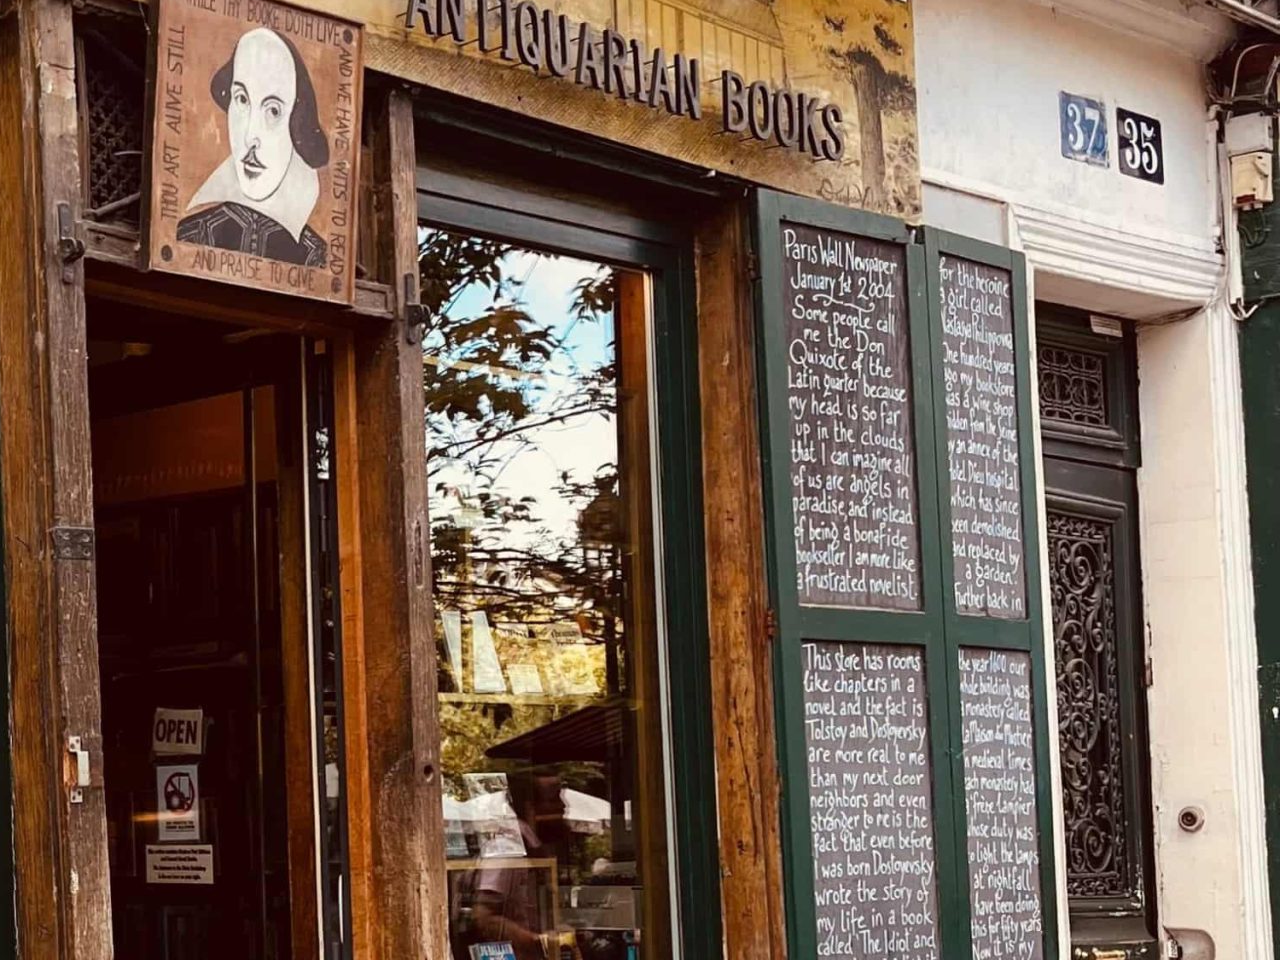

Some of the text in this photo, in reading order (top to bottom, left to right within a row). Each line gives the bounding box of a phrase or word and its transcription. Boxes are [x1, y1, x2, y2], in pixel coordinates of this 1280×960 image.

[247, 1, 280, 31] BOOKE
[284, 9, 314, 36] DOTH
[161, 25, 185, 220] THOU ART ALIVE STILL
[722, 69, 845, 165] BOOKS
[1067, 103, 1100, 155] 37
[330, 46, 353, 276] AND WE HAVE WITS TO READ
[1124, 117, 1158, 174] 35
[192, 248, 316, 290] AND PRAISE TO GIVE
[784, 229, 898, 283] Paris Wall Newspaper
[790, 262, 895, 308] January 1st 2004
[948, 288, 1003, 319] girl called
[792, 294, 896, 336] Some people call
[789, 338, 894, 378] Quixote of the
[803, 325, 885, 356] me the Don
[787, 365, 907, 402] Latin quarter because
[788, 393, 901, 429] my head is so far
[795, 421, 904, 452] up in the clouds
[791, 440, 911, 480] that I can imagine all
[793, 465, 910, 505] of us are angels in
[848, 500, 868, 517] and
[872, 503, 914, 525] instead
[794, 516, 805, 544] of
[808, 519, 839, 549] being
[843, 525, 851, 541] a
[796, 542, 916, 572] bookseller I am more like
[796, 570, 803, 590] a
[805, 564, 868, 596] frustrated
[802, 643, 921, 672] This store has rooms
[155, 718, 198, 744] OPEN
[810, 789, 926, 818] neighbors and even
